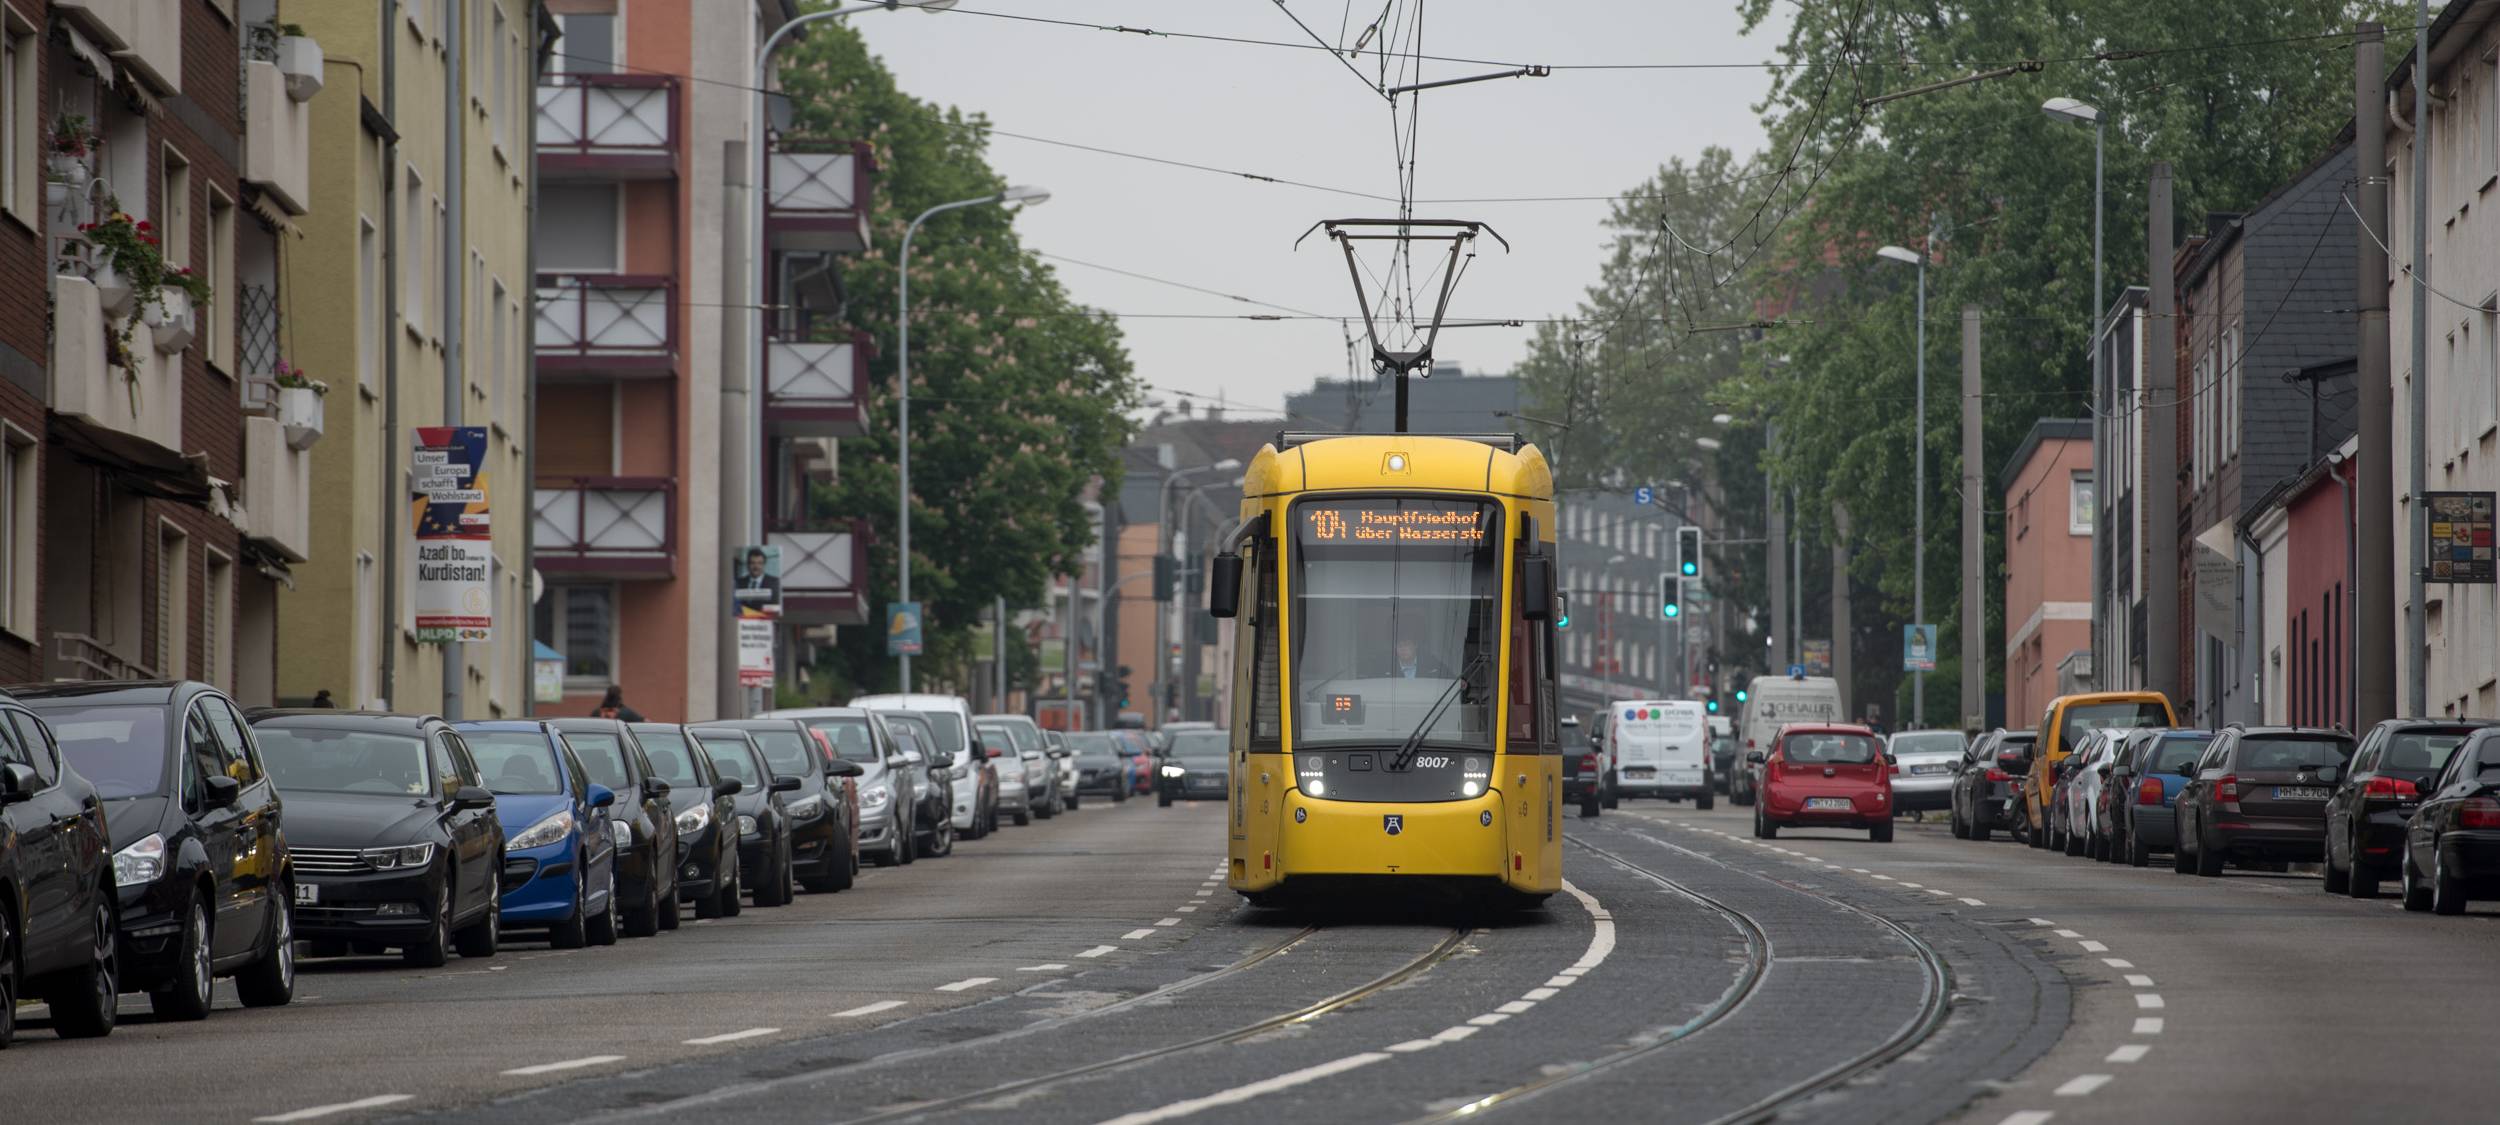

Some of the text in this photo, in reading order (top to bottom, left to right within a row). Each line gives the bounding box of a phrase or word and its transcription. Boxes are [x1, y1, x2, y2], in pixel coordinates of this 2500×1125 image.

[417, 454, 445, 462] Unser
[434, 466, 467, 476] Europa
[421, 479, 454, 488] schafft
[432, 492, 482, 501] Wohlstand
[1638, 487, 1650, 504] S
[1310, 510, 1346, 539] 104
[1360, 511, 1480, 526] Hauptfriedhof
[1355, 527, 1484, 539] über Wasserstr
[451, 545, 465, 561] bo
[419, 563, 485, 581] Kurdistan!
[419, 628, 454, 640] MLPD
[1416, 756, 1449, 768] 8007
